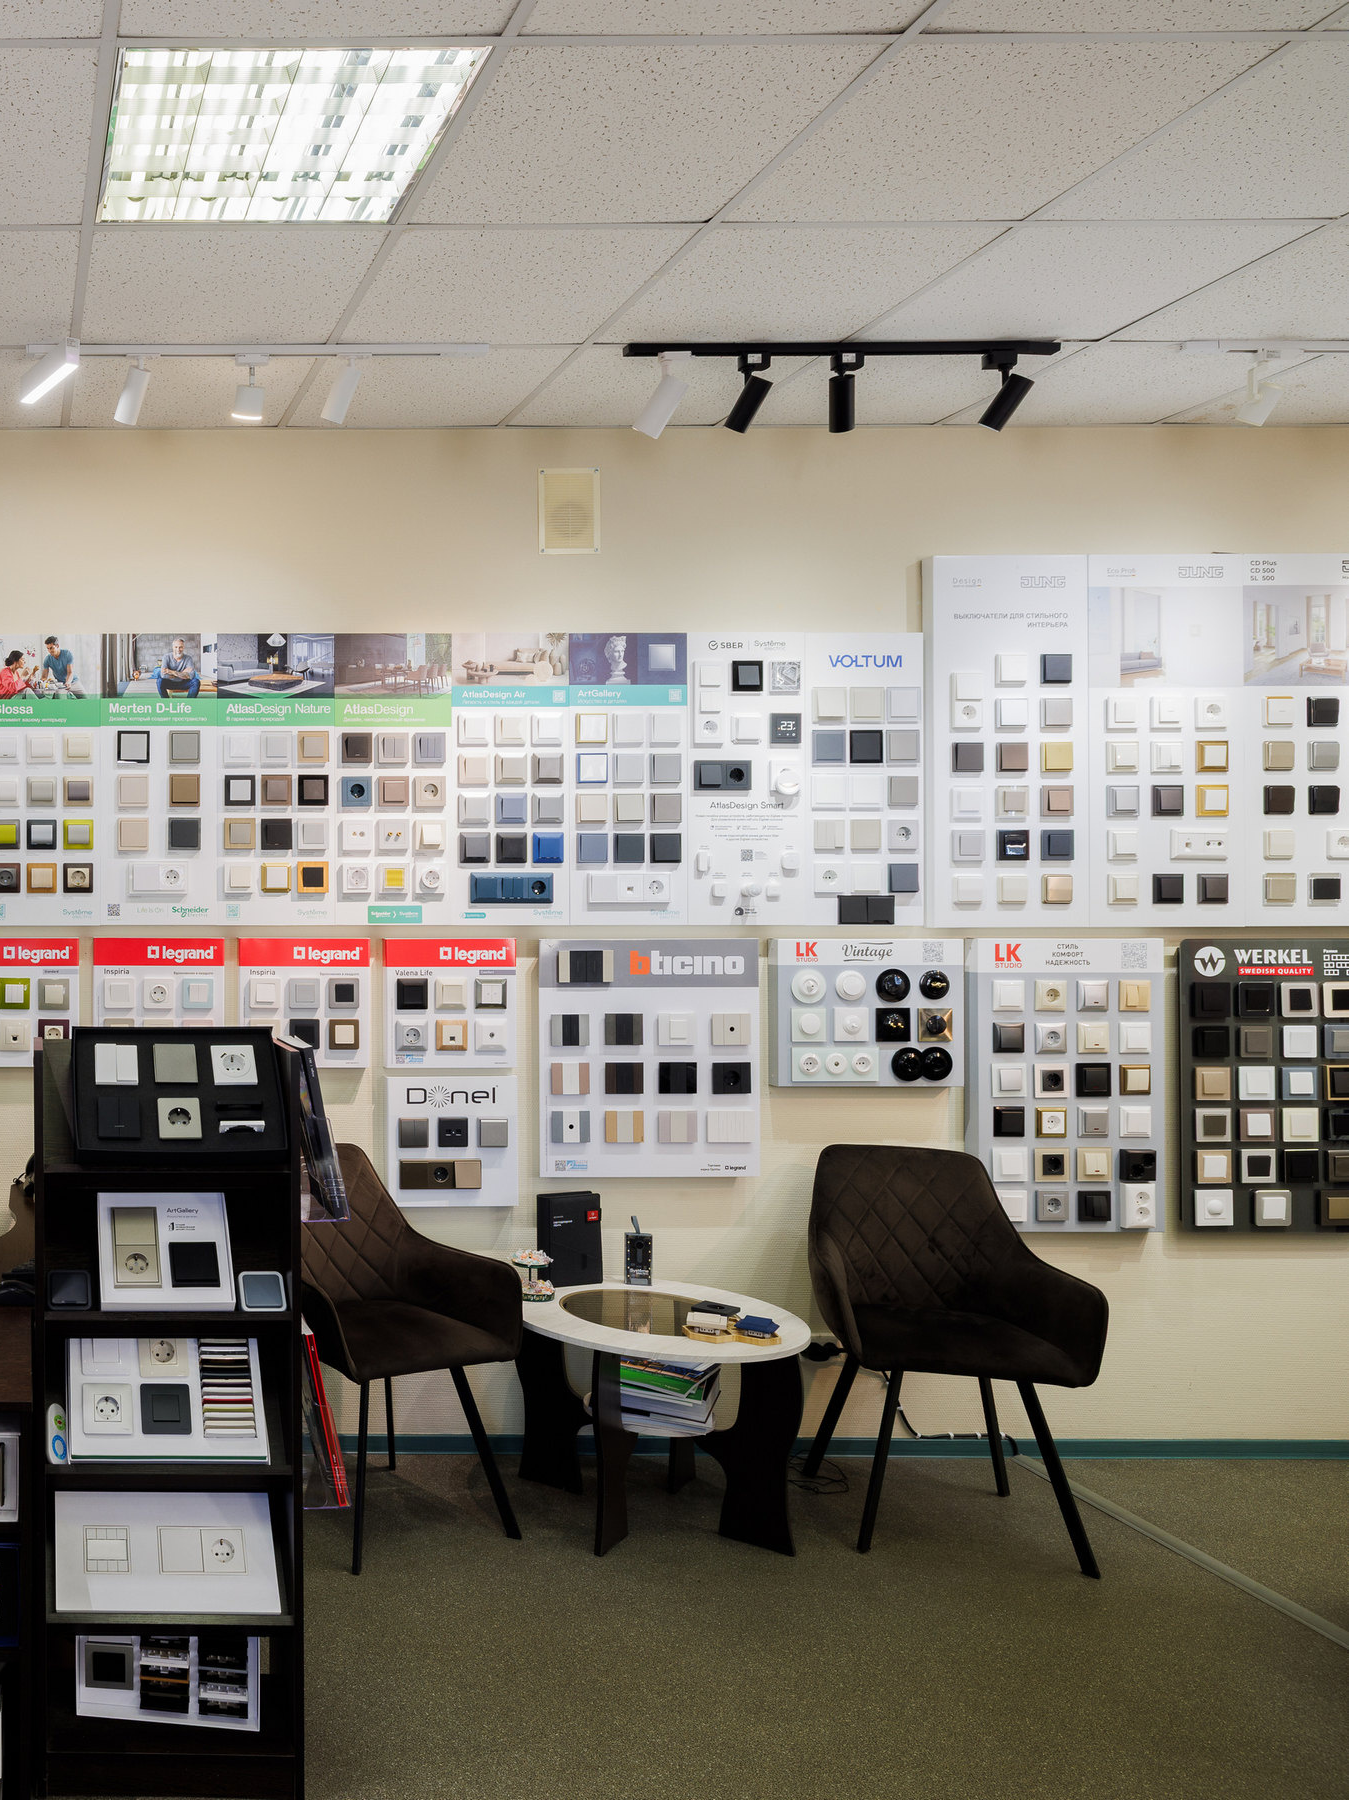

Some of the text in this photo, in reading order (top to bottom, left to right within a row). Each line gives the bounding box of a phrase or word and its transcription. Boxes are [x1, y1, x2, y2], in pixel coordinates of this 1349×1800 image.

[1106, 567, 1120, 575] Eco
[1177, 565, 1224, 579] JUNG
[952, 577, 982, 586] Design
[1020, 576, 1066, 589] JUNG
[1025, 612, 1069, 620] СТИЛЬНОГО
[828, 655, 903, 668] VOLTUM
[462, 690, 527, 700] AtlasDesign Air
[577, 689, 622, 699] ArtGallery
[109, 703, 192, 714] Merten D-Life
[226, 703, 331, 716] AtlasDesign Nature
[343, 704, 414, 717] AtlasDesign
[709, 801, 784, 811] AtlasDesign Smart
[171, 906, 209, 915] Schneider
[18, 945, 70, 963] legrand
[162, 945, 214, 963] legrand
[308, 946, 360, 964] legrand
[454, 946, 506, 964] legrand
[795, 941, 818, 957] LK
[841, 944, 893, 960] Vintage
[994, 943, 1022, 962] LK
[630, 950, 745, 975] bticino
[1045, 959, 1091, 967] НАДЕЖНОСТЬ
[1233, 949, 1313, 964] WERKEL
[103, 967, 130, 975] Inspiria
[249, 968, 276, 976] Inspiria
